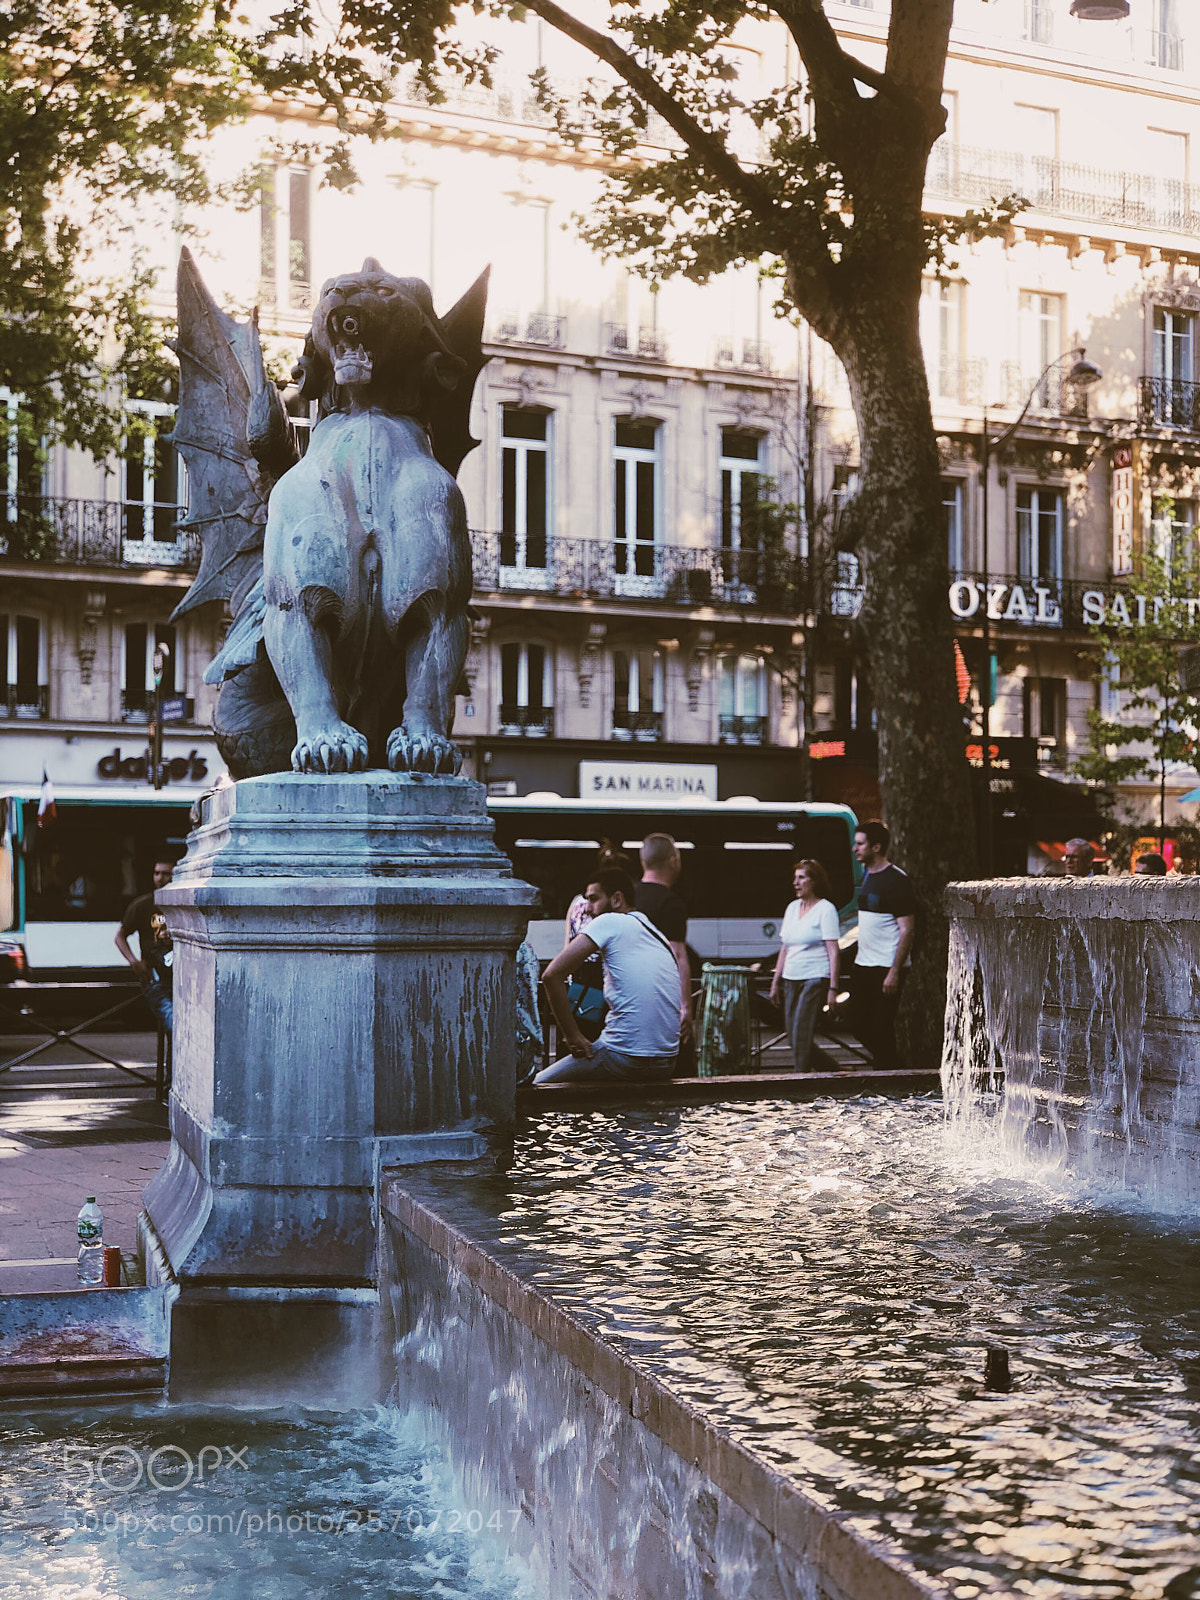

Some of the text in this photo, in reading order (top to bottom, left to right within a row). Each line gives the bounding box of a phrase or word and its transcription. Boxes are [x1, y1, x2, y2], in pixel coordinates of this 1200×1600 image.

[1115, 471, 1130, 573] HOTEL
[948, 580, 1061, 623] OYAL
[592, 775, 706, 793] SAN MARINA
